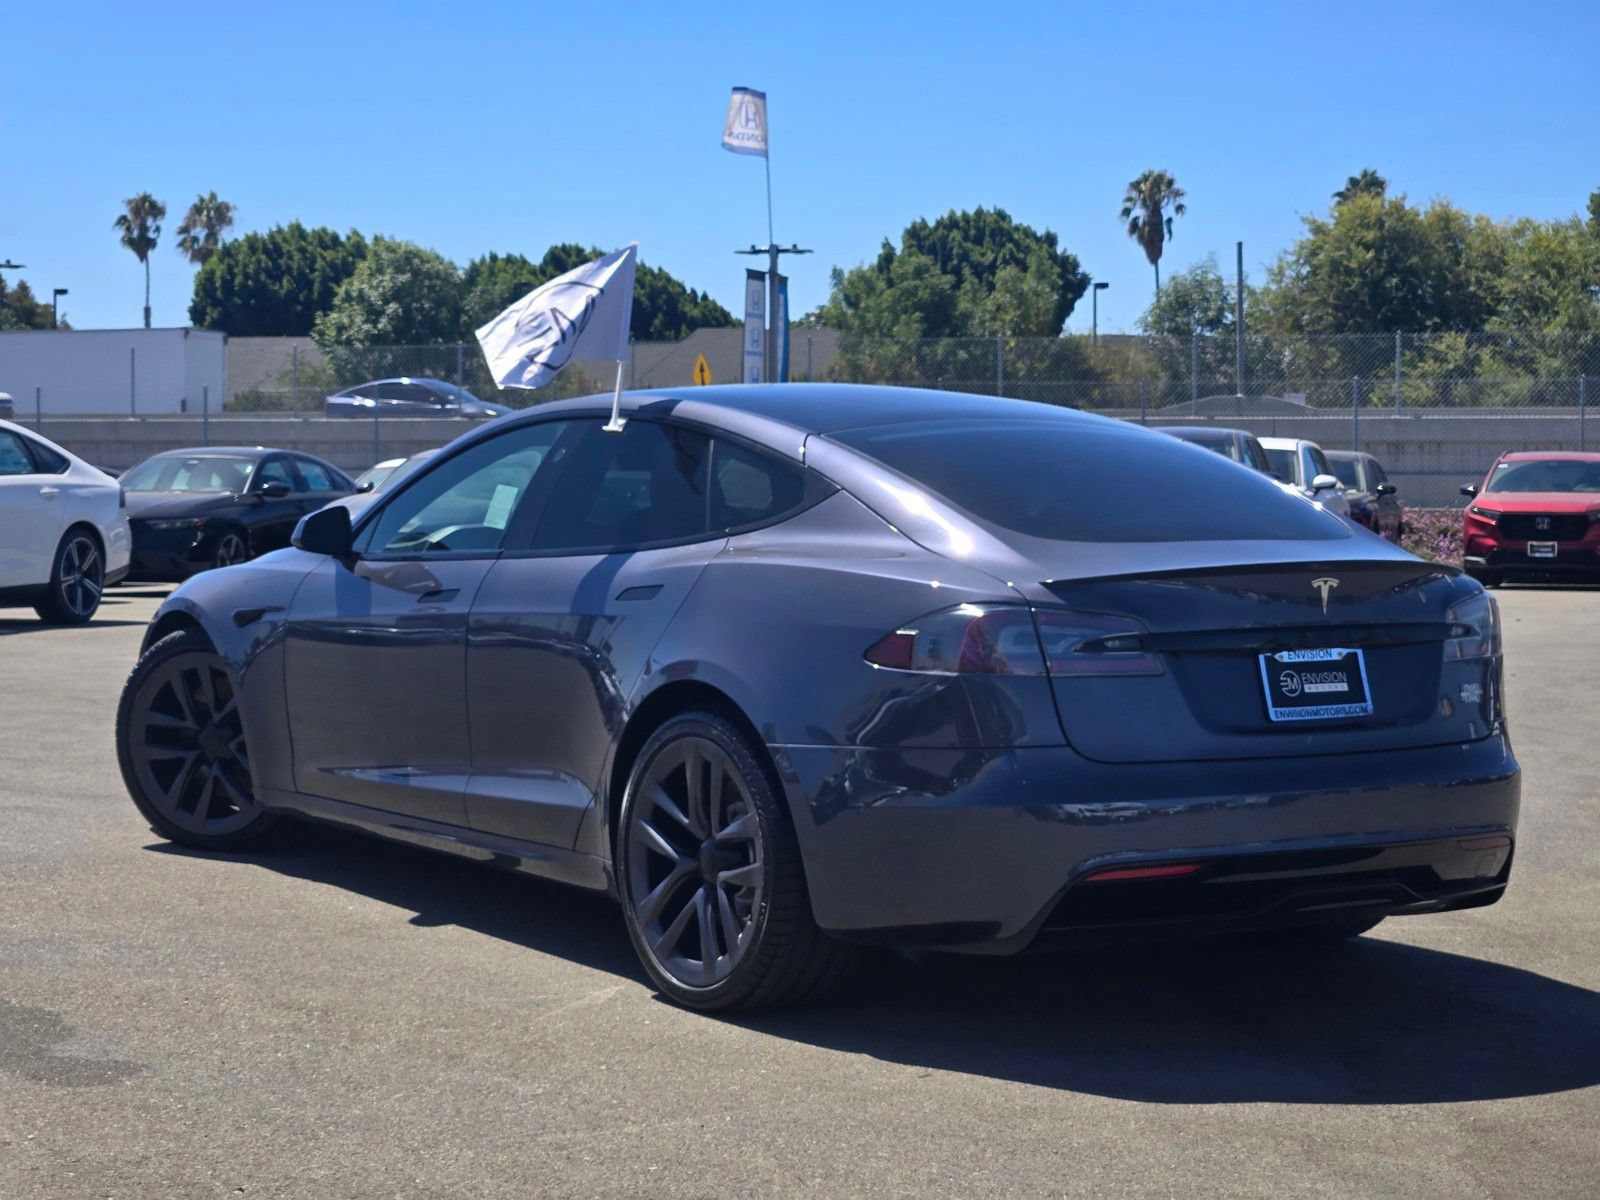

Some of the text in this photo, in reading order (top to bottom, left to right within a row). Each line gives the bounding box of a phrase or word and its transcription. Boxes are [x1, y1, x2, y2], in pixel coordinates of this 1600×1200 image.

[1287, 648, 1332, 660] ENVISION
[1301, 671, 1347, 684] ENVISION
[1274, 705, 1369, 719] ENVISIONMOTORS.COM
